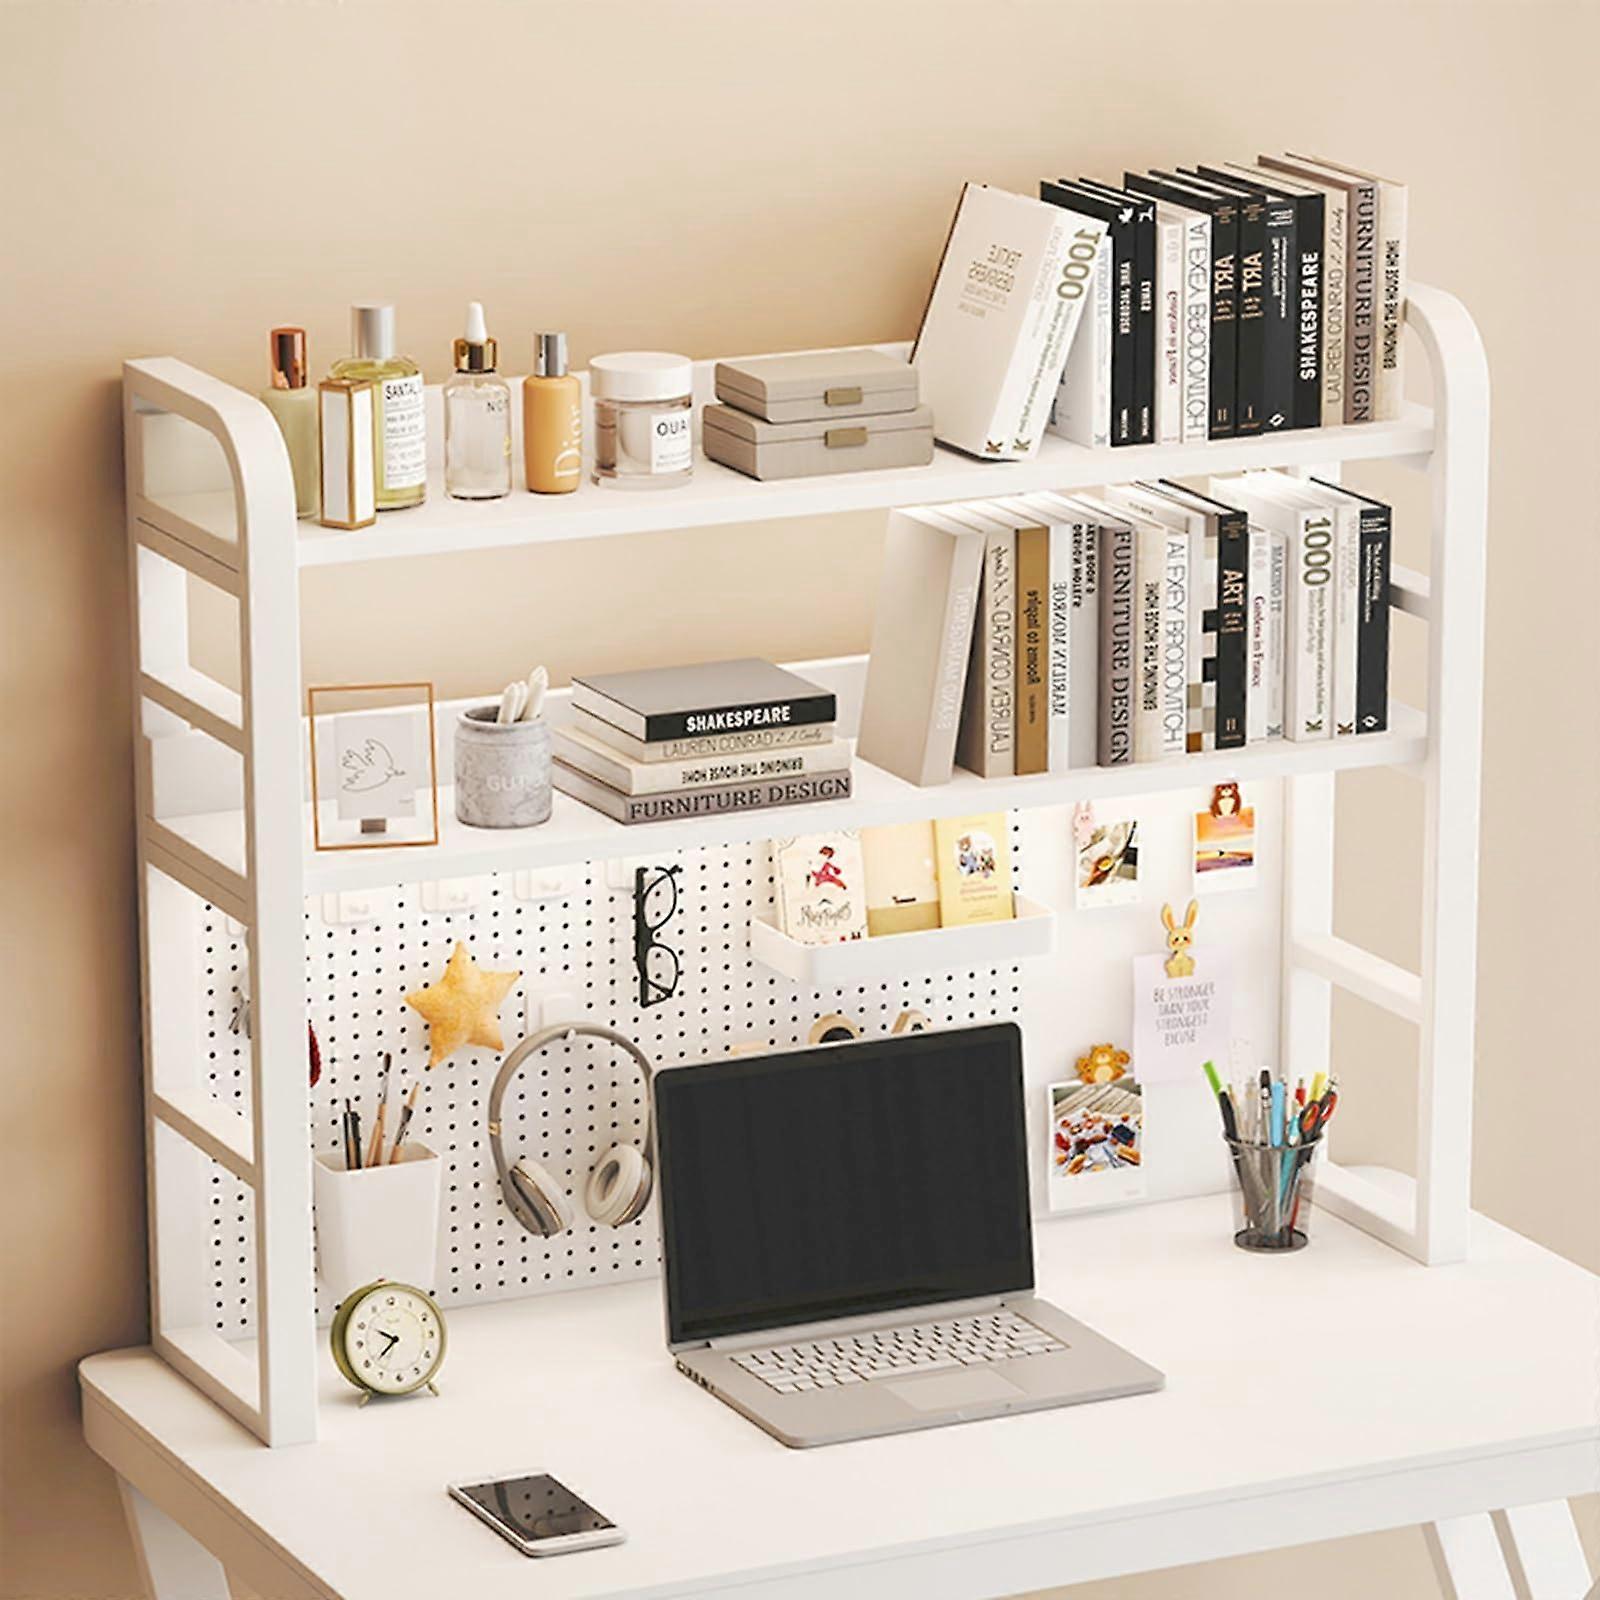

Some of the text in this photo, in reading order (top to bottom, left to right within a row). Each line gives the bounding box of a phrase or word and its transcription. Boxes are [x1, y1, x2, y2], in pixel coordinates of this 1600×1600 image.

[1300, 251, 1319, 381] SHAKESPEARE
[1327, 269, 1343, 333] CONRAD
[1352, 187, 1374, 422] FURNITURE DESIGN
[1327, 338, 1342, 403] LAUREN
[554, 405, 582, 477] Dior
[1302, 517, 1332, 586] 1000
[1224, 569, 1244, 606] ART
[1110, 530, 1132, 764] FURNITURE DESIGN
[1252, 653, 1265, 688] France
[663, 738, 717, 758] LAUREN
[719, 732, 774, 753] CONRAD
[686, 705, 791, 733] SHAKESPEARE
[630, 777, 850, 820] FURNITURE DESIGN
[1153, 981, 1215, 1003] BE STRONGER
[1158, 1001, 1184, 1016] THAN
